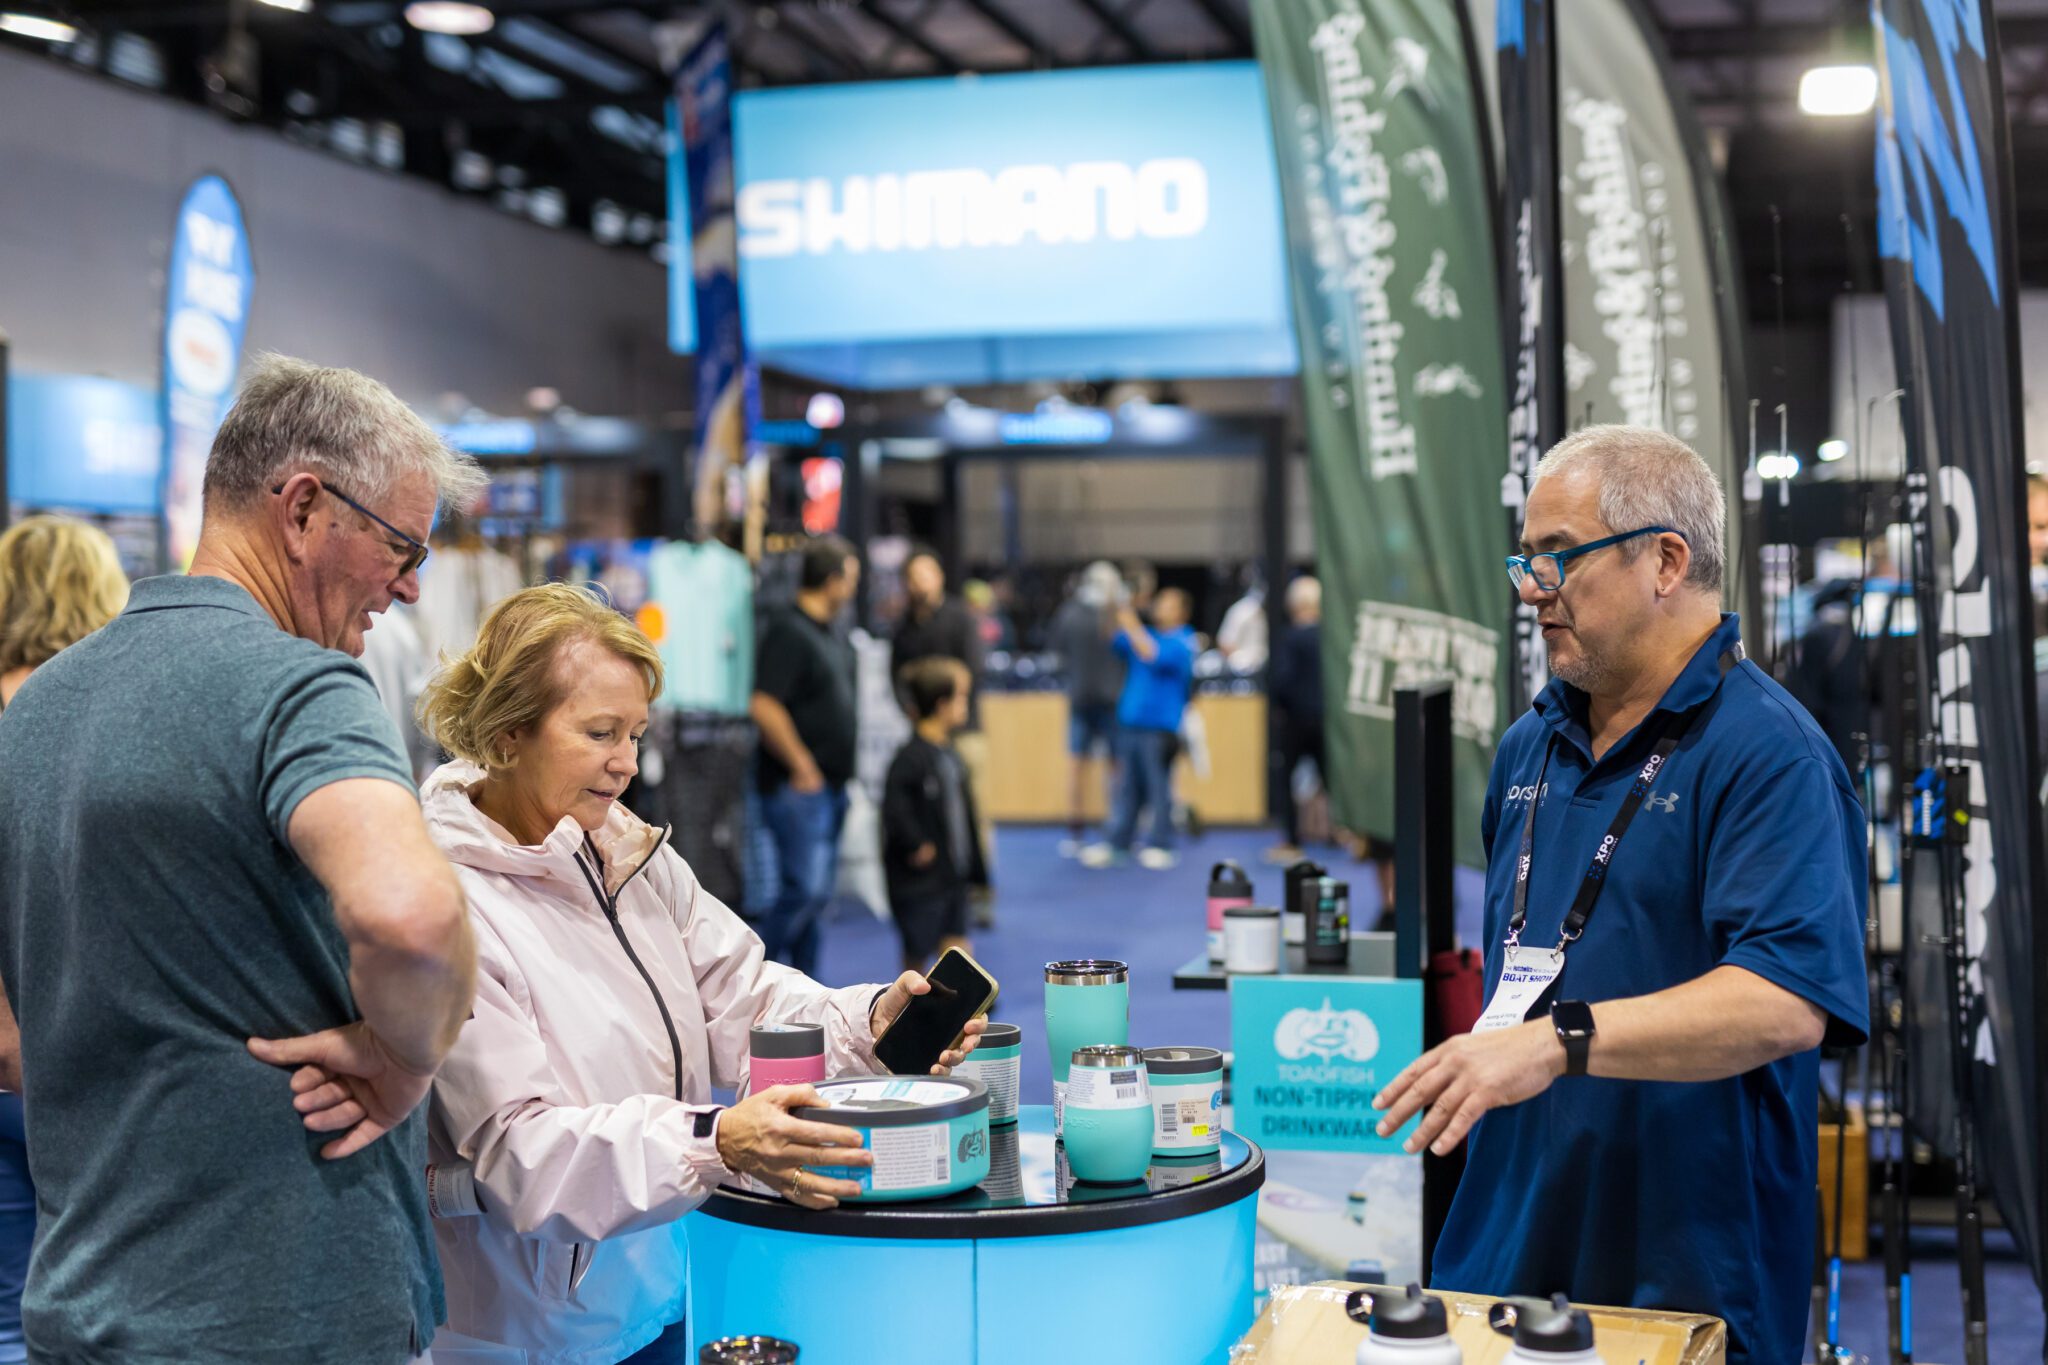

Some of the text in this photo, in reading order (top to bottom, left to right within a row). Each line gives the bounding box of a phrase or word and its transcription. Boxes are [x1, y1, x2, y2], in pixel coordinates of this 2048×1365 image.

[738, 157, 1207, 258] SHIMANO
[1639, 755, 1661, 781] XPO
[1594, 834, 1614, 863] XPO
[1520, 854, 1530, 881] XPO
[1502, 973, 1528, 983] BOAT
[1276, 1064, 1375, 1084] TOADFISH
[1261, 1115, 1392, 1140] DRINKWAR
